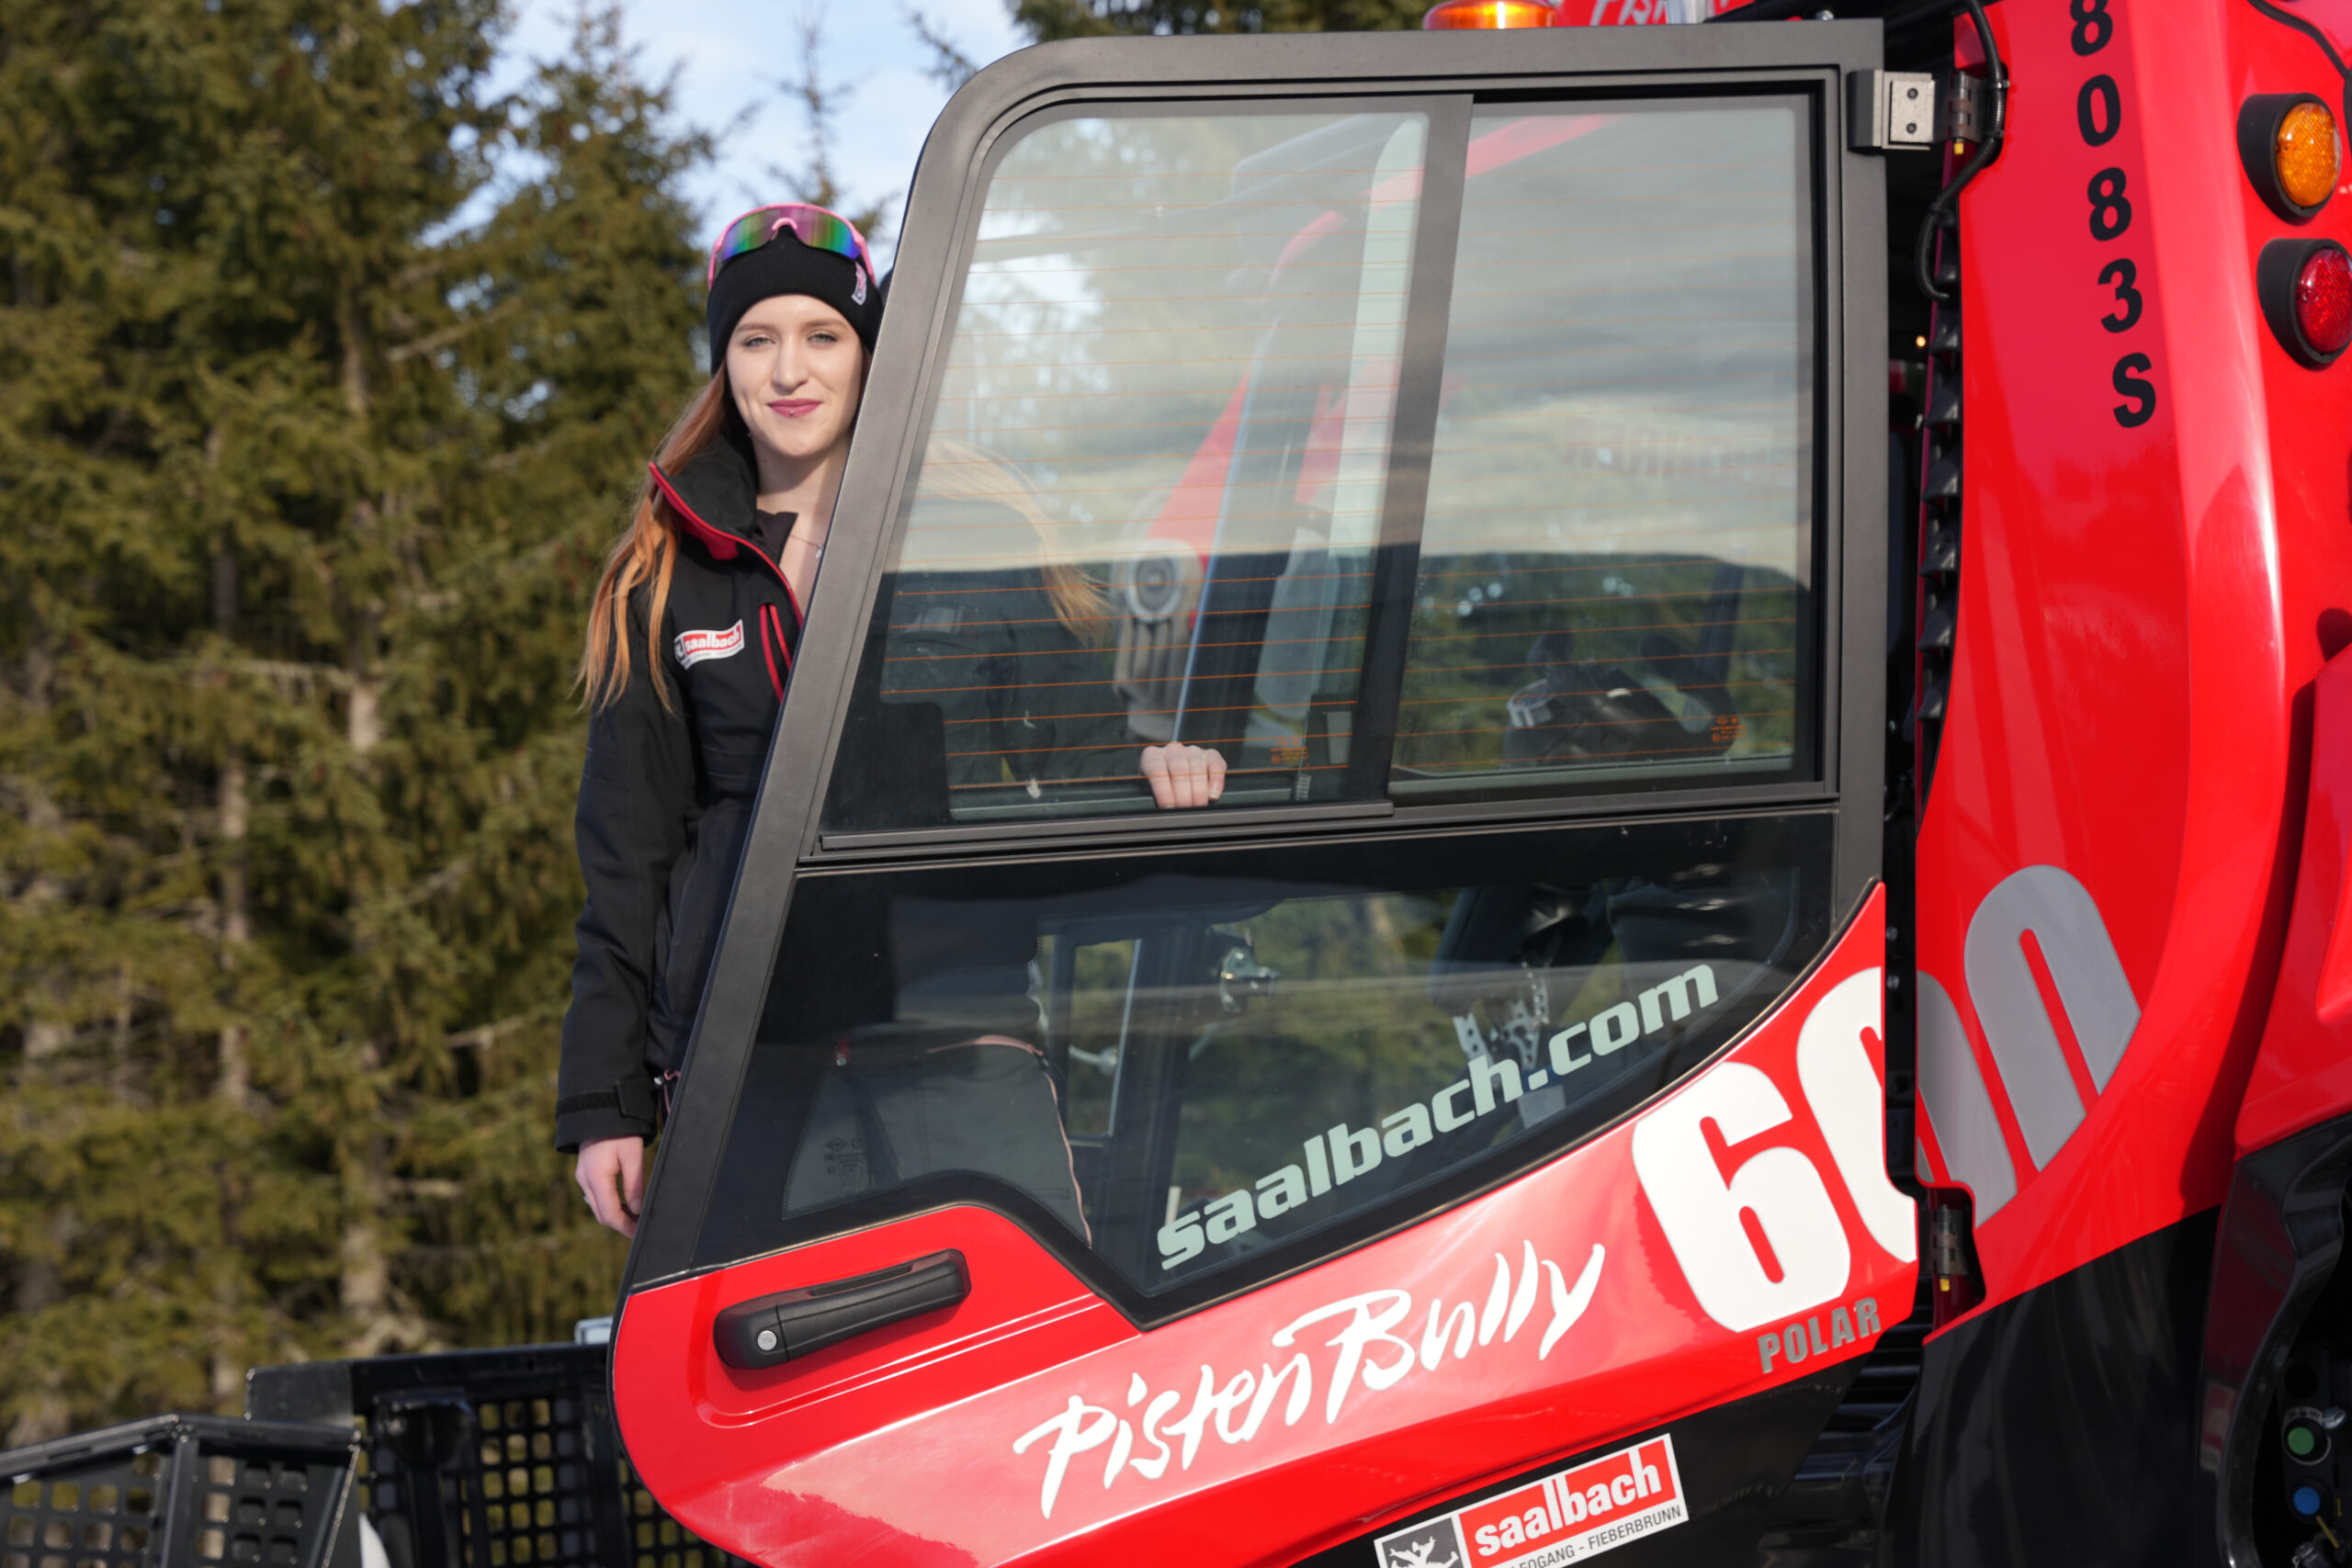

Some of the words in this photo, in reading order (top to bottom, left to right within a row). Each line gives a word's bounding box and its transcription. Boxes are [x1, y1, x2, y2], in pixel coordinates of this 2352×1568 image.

[684, 627, 740, 652] saalbach
[1157, 964, 1718, 1270] saalbach.com
[1757, 1296, 1882, 1374] POLAR
[1475, 1447, 1663, 1557] saalbach
[1511, 1544, 1575, 1568] OGANG
[1588, 1505, 1681, 1550] FIEBERBRUNN
